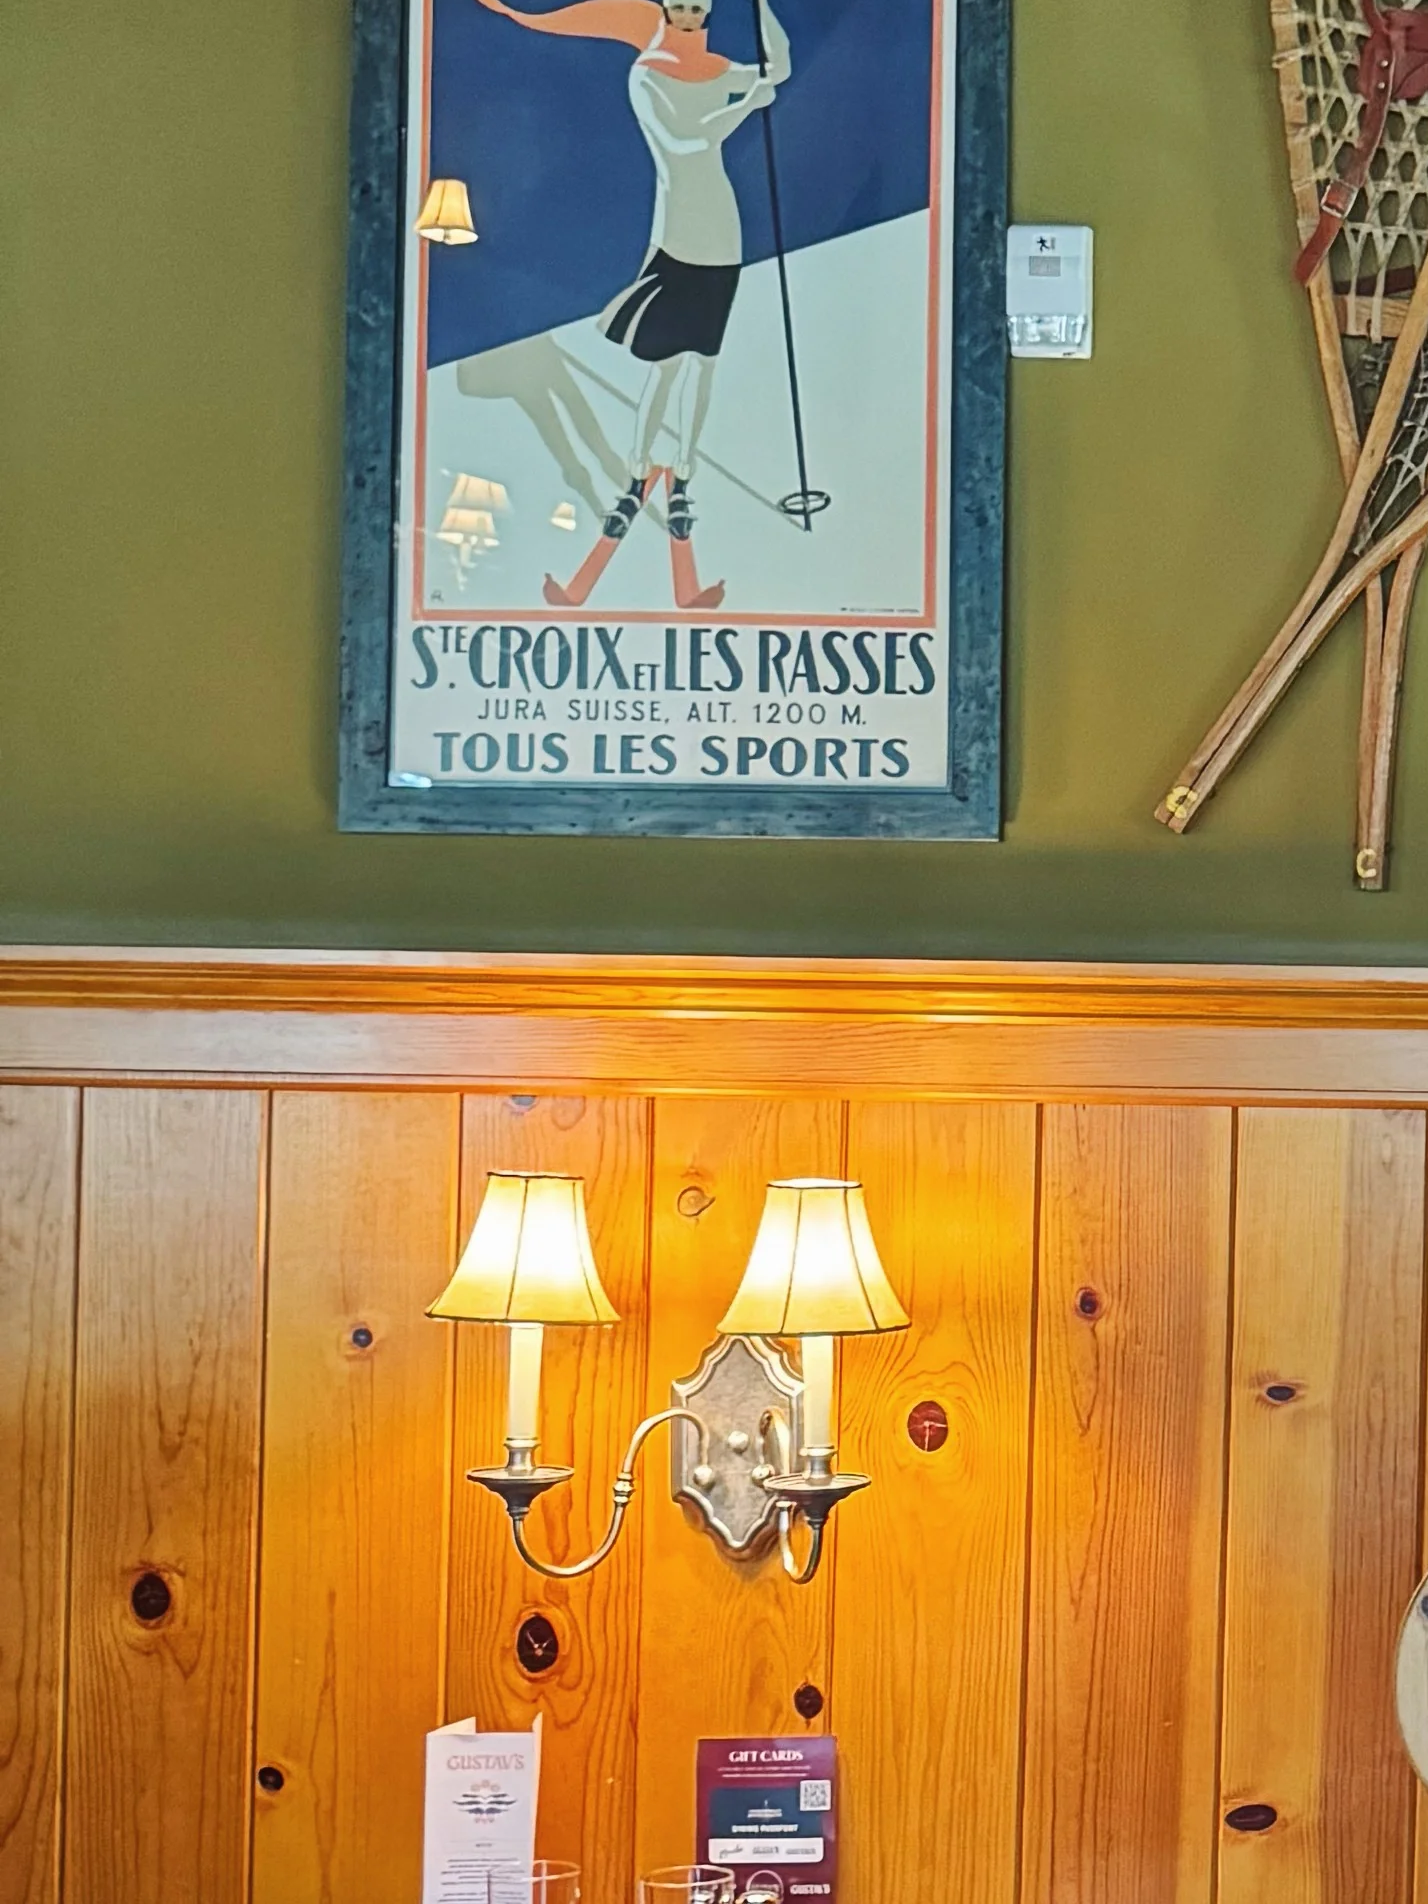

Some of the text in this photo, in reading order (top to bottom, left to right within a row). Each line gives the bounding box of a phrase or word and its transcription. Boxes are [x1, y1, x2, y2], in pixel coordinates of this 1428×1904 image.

[468, 626, 631, 693] CROIX
[634, 663, 661, 691] ET
[665, 628, 743, 692] LES
[758, 630, 936, 697] RASSES
[477, 698, 867, 726] JURA SUISSE, ALT. 1200 M.
[433, 732, 910, 780] TOUS LES SPORTS
[447, 1753, 525, 1771] GUSTAV'S
[728, 1749, 804, 1763] GIFT CARDS
